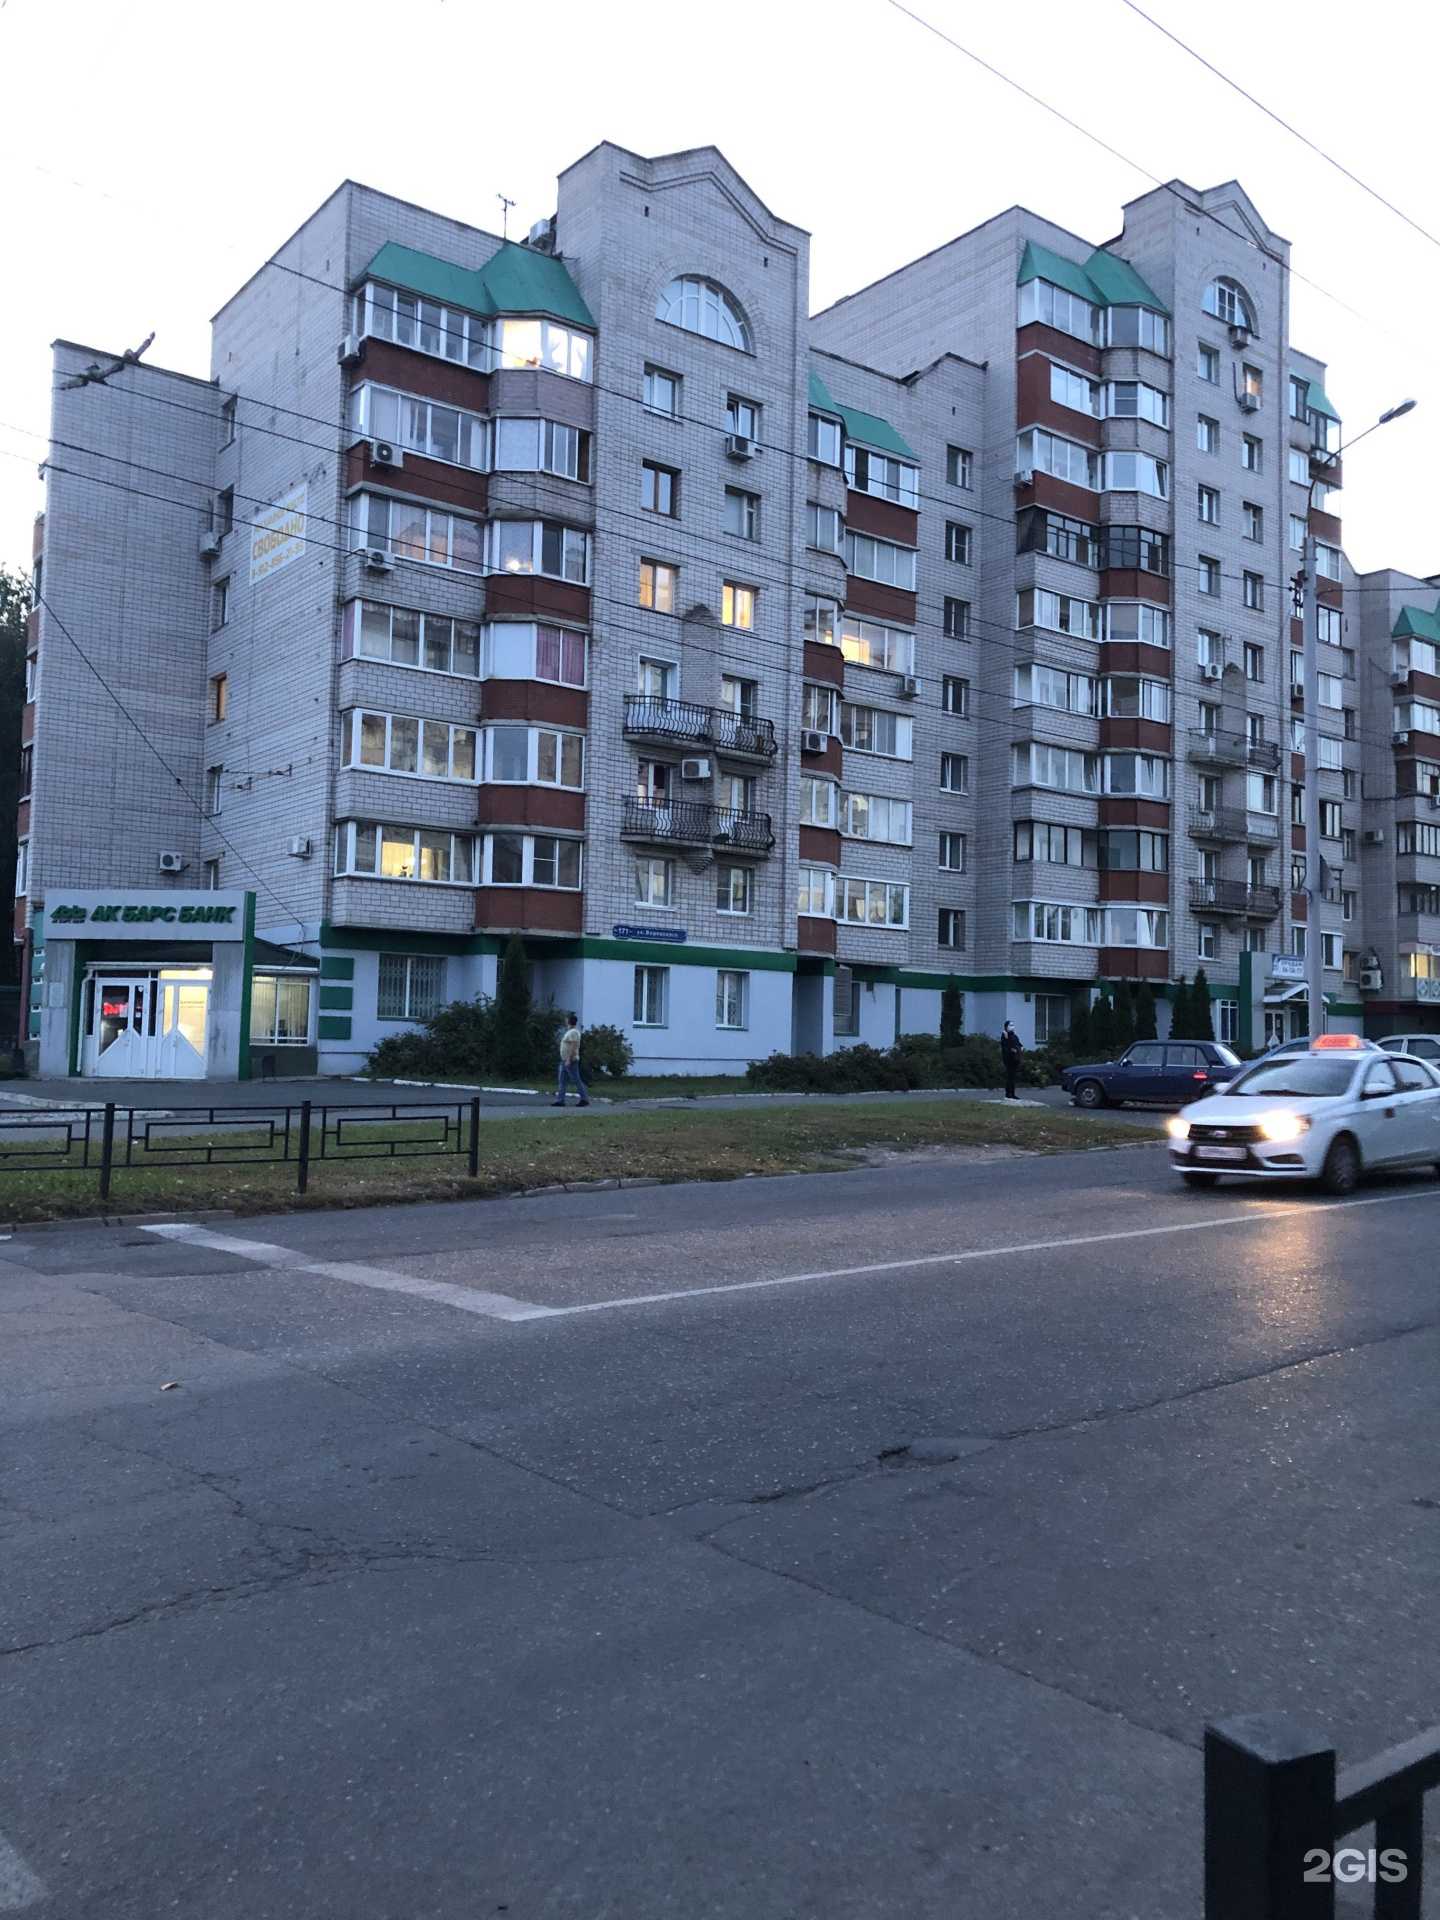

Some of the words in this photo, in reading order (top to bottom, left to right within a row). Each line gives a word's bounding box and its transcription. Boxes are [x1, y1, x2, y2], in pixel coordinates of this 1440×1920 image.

[90, 905, 122, 922] АК
[121, 905, 176, 923] БАРС
[178, 905, 237, 924] БАНК
